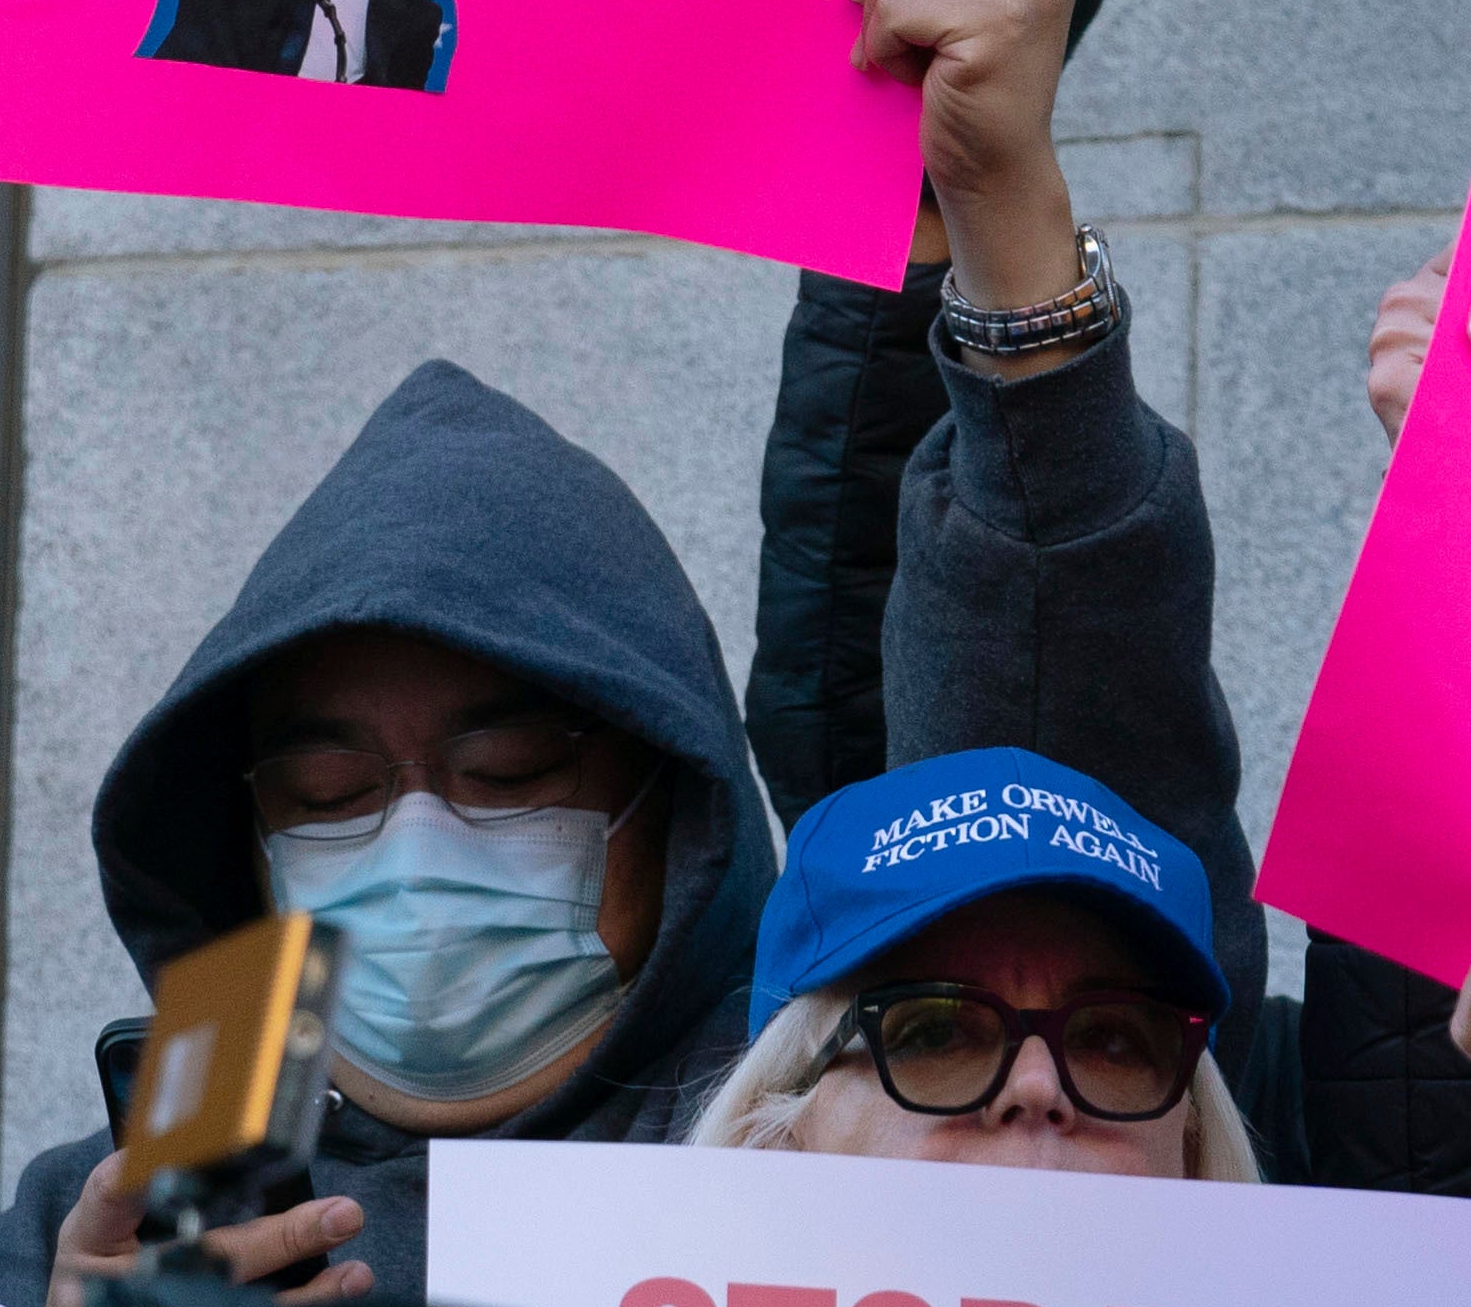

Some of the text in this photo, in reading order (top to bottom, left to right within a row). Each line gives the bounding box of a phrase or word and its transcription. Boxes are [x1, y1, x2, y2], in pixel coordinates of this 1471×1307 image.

[861, 813, 1163, 891] FICTION AGAIN
[871, 783, 1158, 858] MAKE ORWELL
